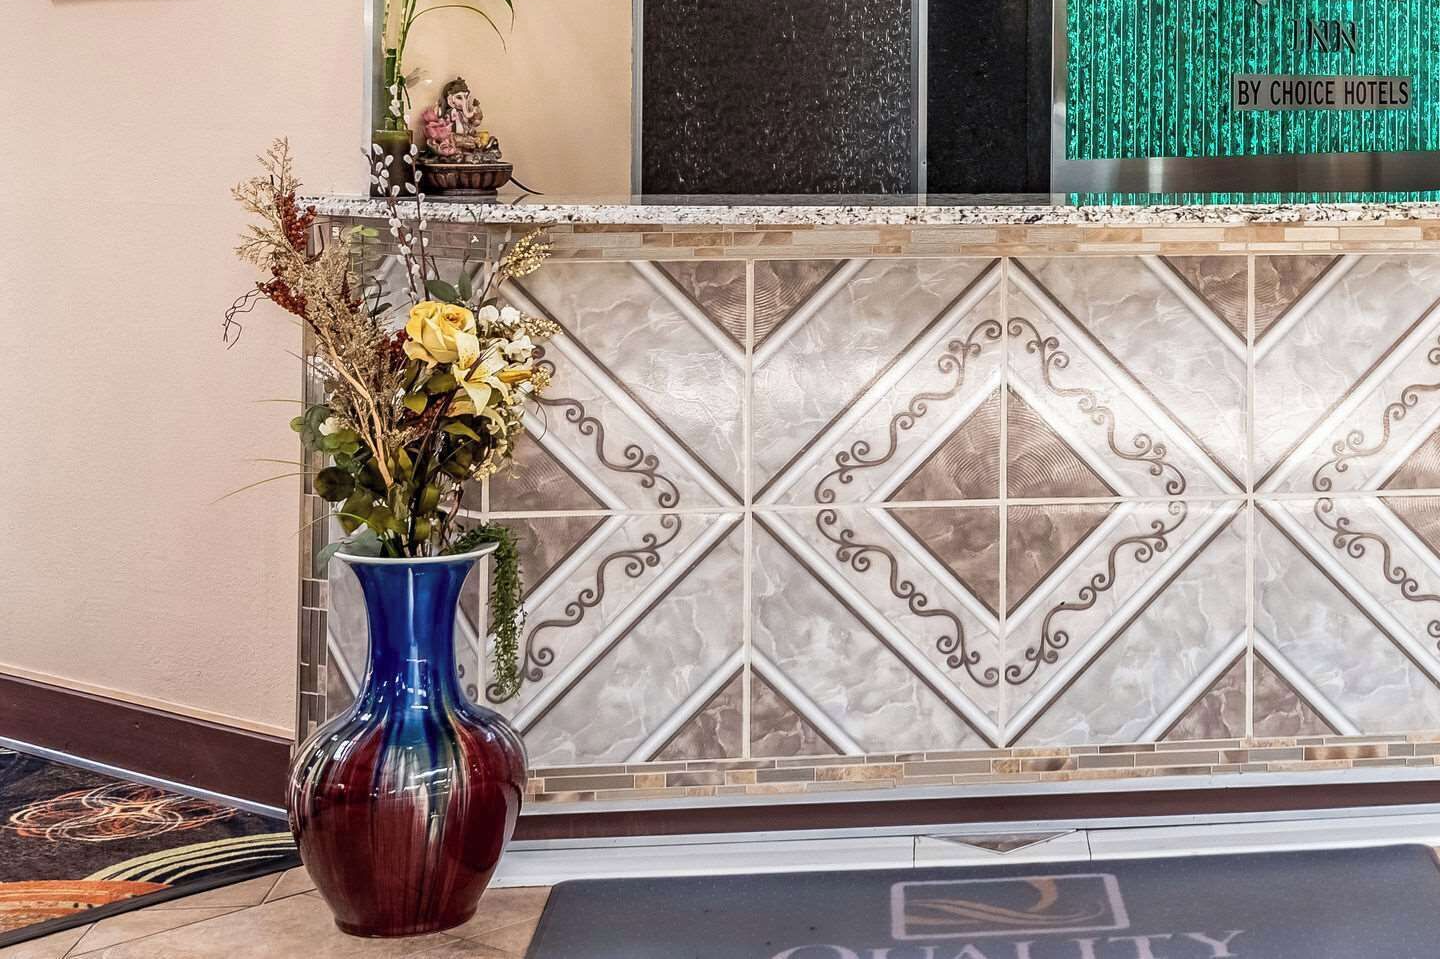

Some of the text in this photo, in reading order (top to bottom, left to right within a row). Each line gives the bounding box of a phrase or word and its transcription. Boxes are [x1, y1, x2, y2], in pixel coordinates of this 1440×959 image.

[1290, 18, 1357, 54] INN
[1237, 80, 1409, 106] BY CHOICE HOTELS
